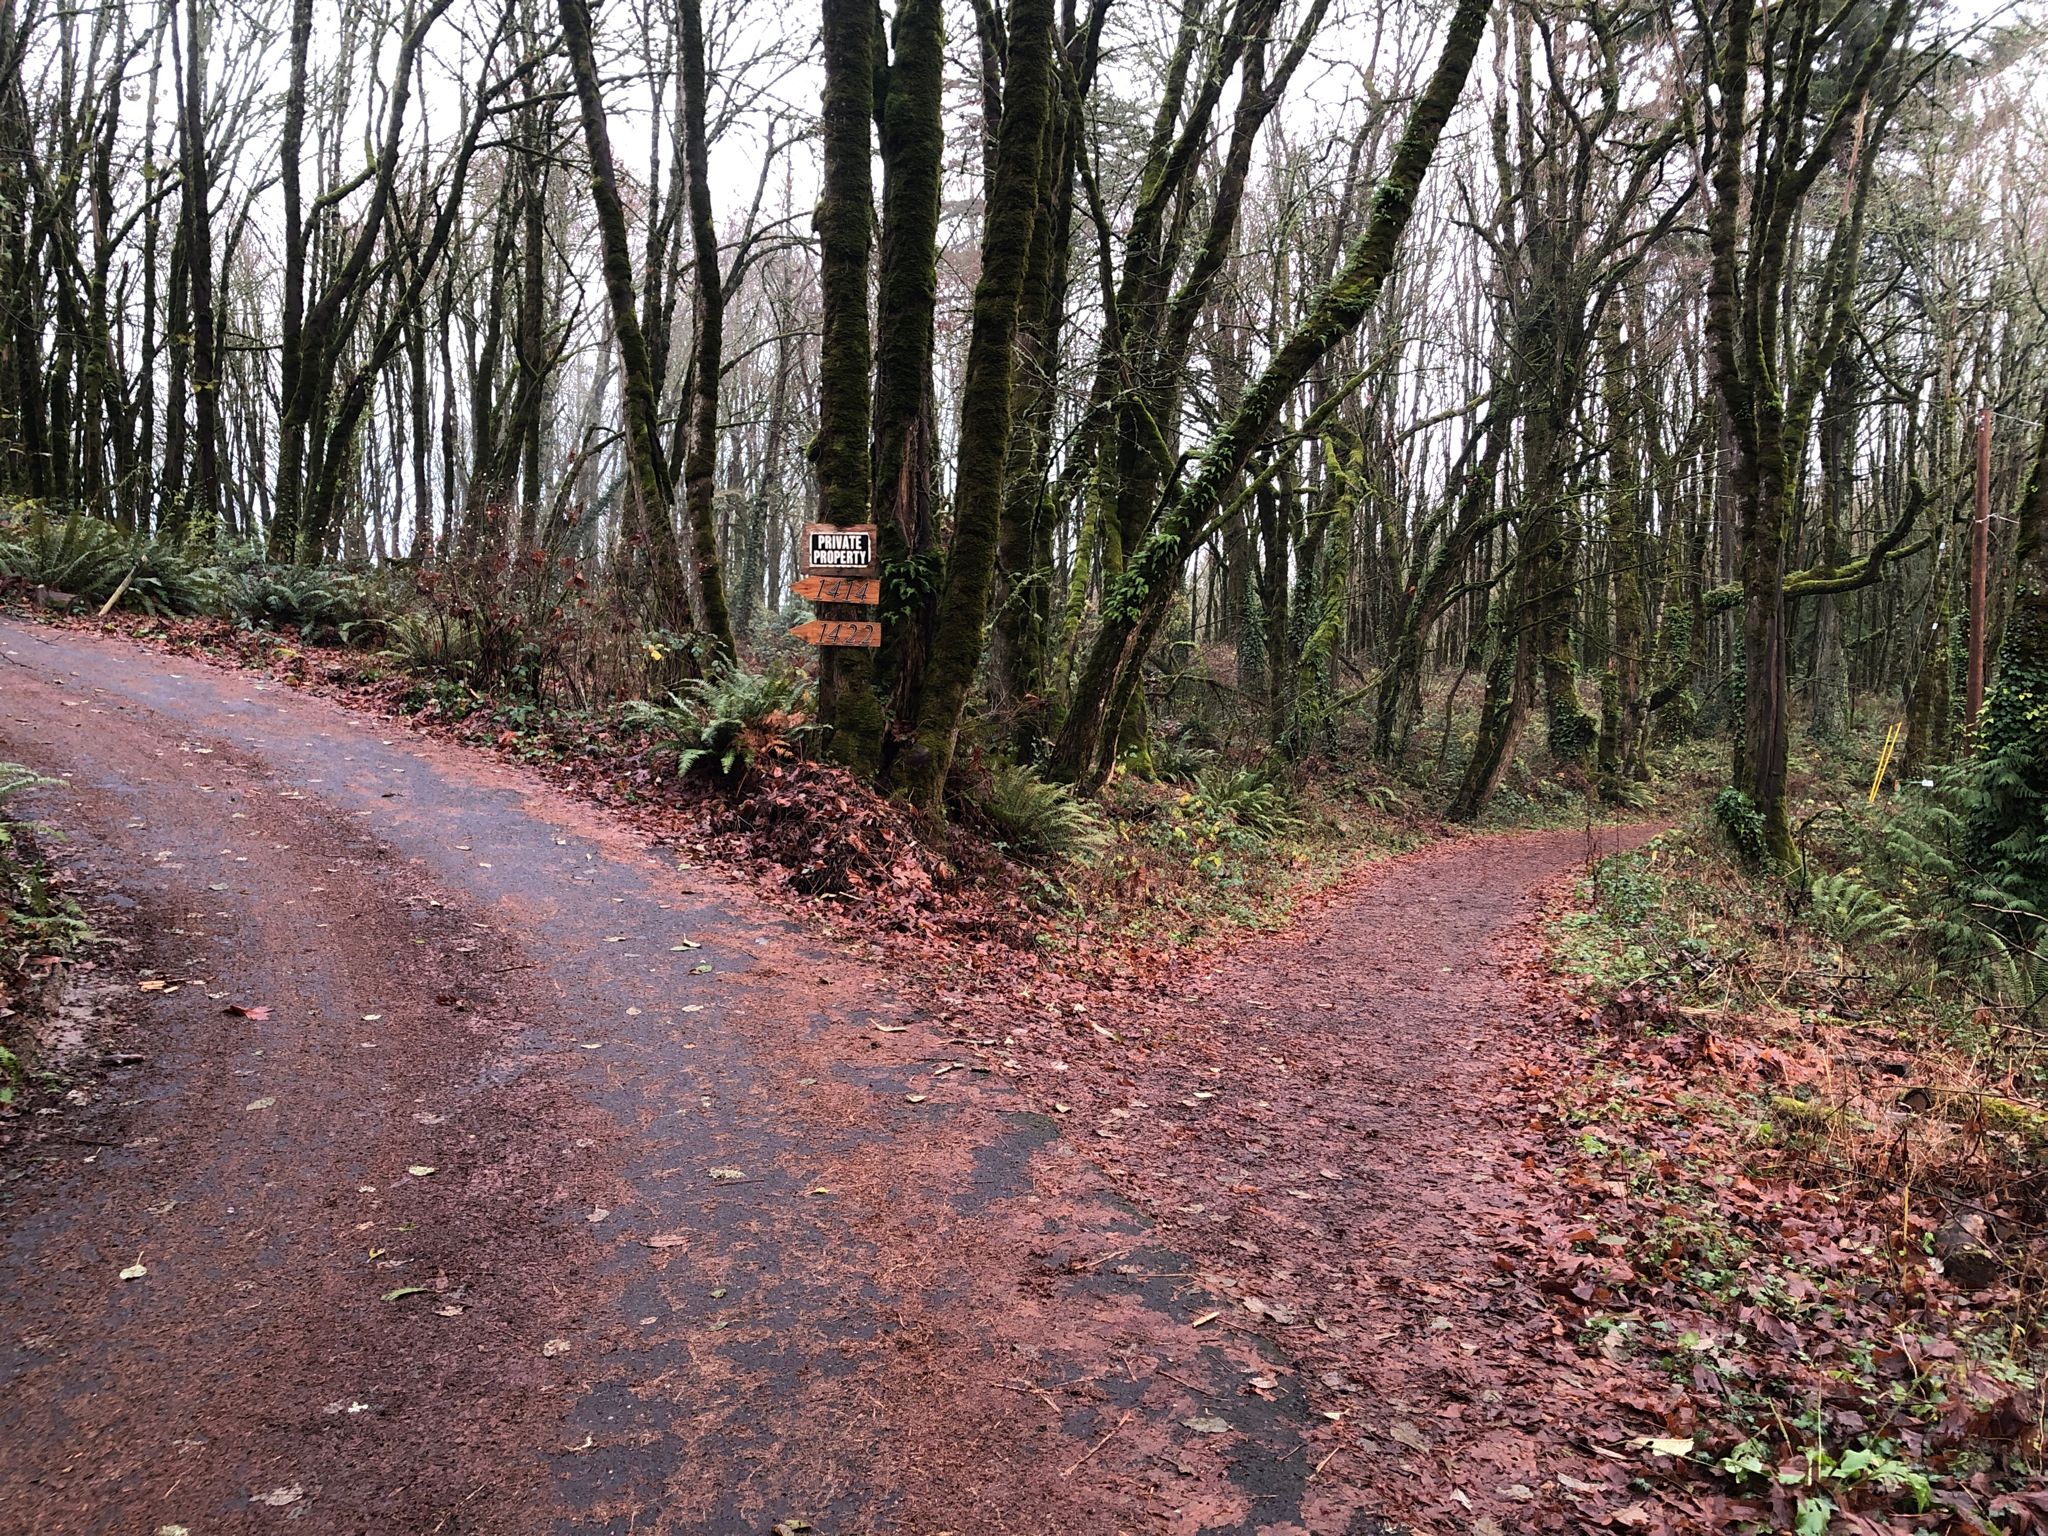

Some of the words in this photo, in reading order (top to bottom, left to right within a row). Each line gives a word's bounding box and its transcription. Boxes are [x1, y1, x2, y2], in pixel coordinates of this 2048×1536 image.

[818, 535, 862, 550] PRIVATE
[813, 550, 867, 564] PROPERTY
[815, 579, 869, 600] 1414
[816, 623, 874, 645] 1422
